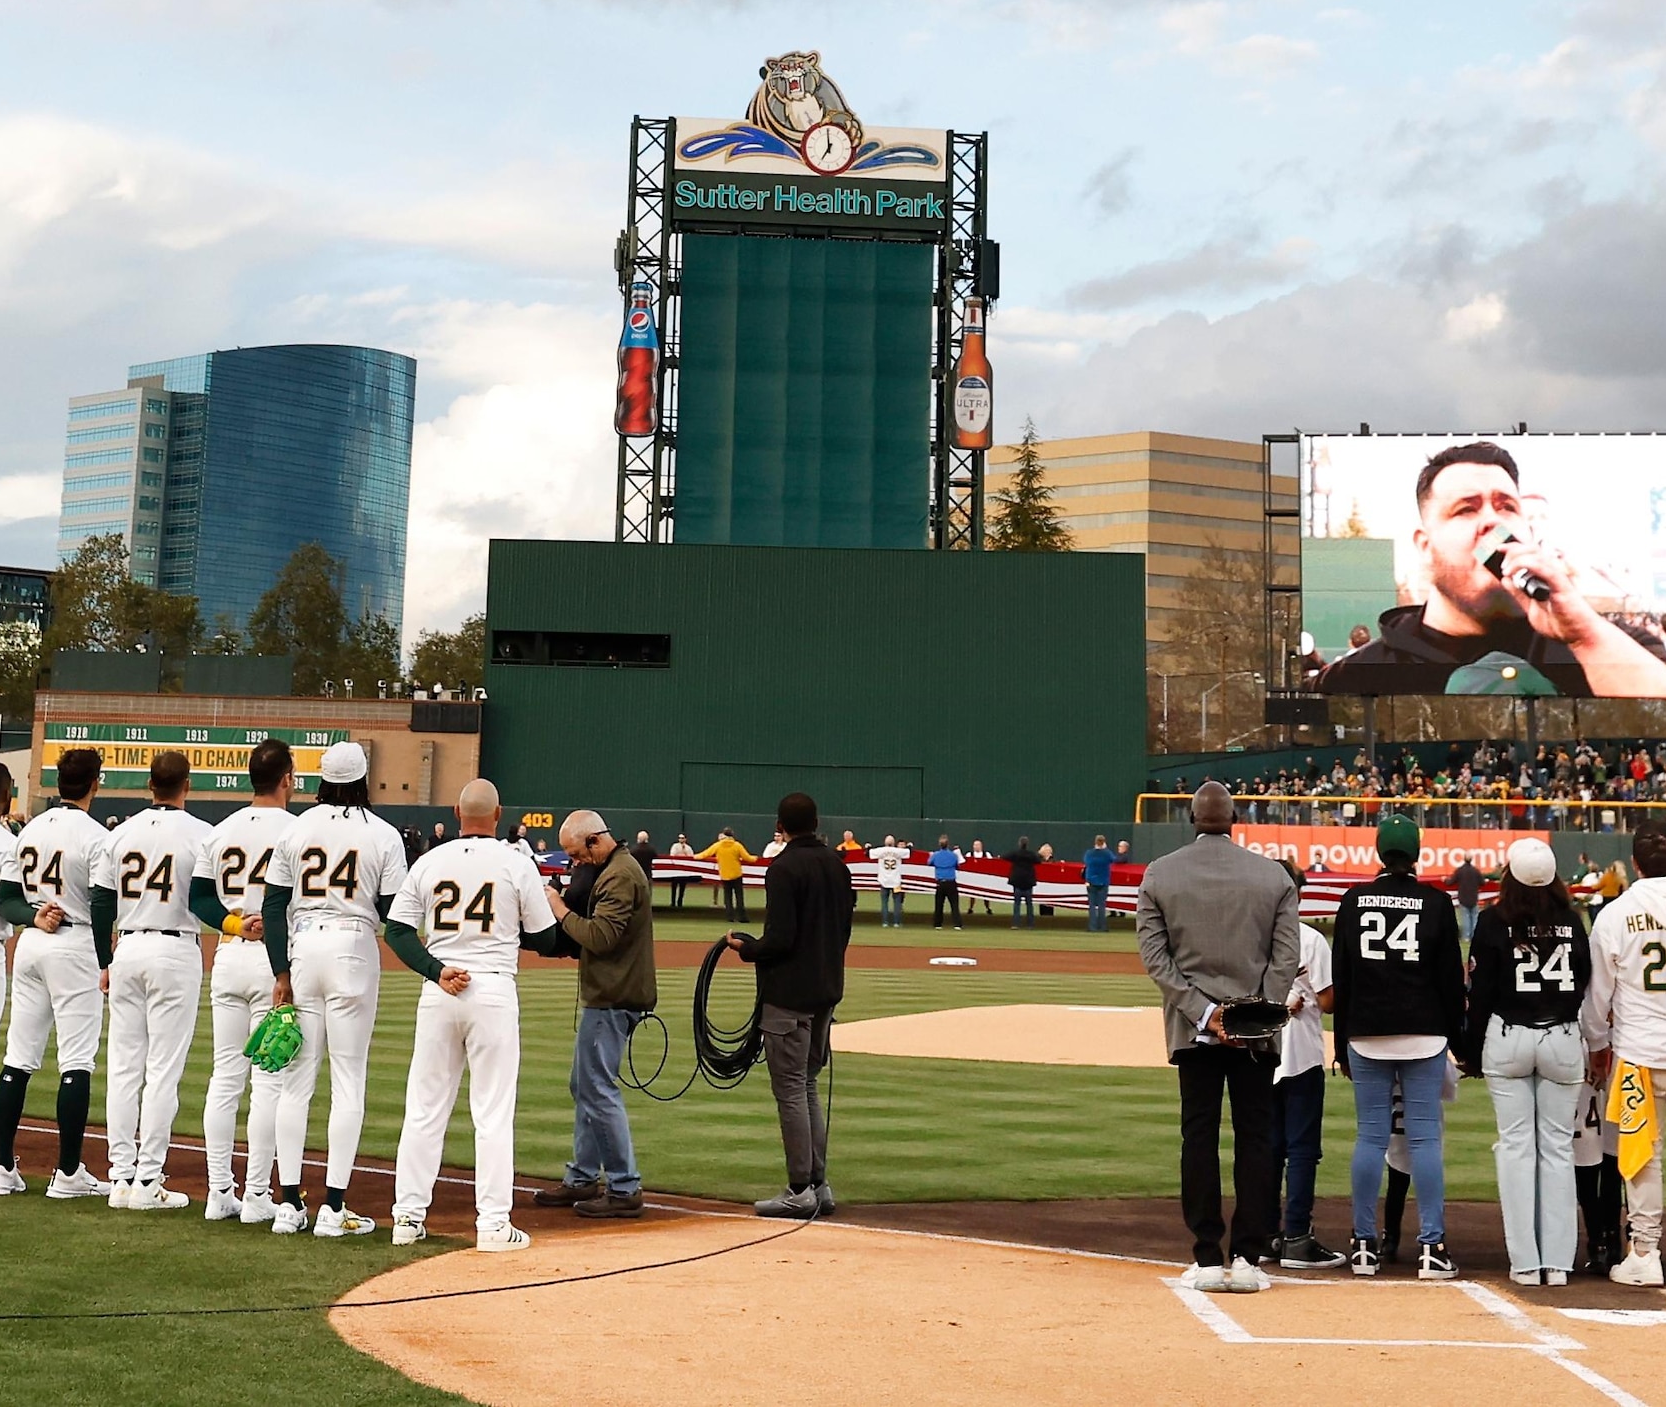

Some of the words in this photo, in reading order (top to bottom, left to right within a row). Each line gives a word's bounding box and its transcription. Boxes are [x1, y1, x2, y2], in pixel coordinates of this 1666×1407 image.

[675, 180, 770, 210] Sutter
[774, 185, 871, 215] Health
[876, 190, 944, 219] Park
[957, 399, 988, 408] ULTRA
[65, 726, 88, 739] 1910
[125, 728, 148, 740] 1911
[185, 729, 208, 742] 1913
[305, 732, 328, 744] 1930
[216, 775, 238, 788] 1974
[521, 813, 553, 828] 403
[19, 845, 64, 896] 24
[121, 846, 174, 902] 24
[221, 846, 274, 897] 24
[300, 847, 359, 901] 24
[884, 859, 896, 870] 52
[433, 880, 496, 934] 24
[1357, 895, 1423, 910] HENDERSON
[1360, 911, 1421, 962] 24
[1514, 943, 1575, 993] 24
